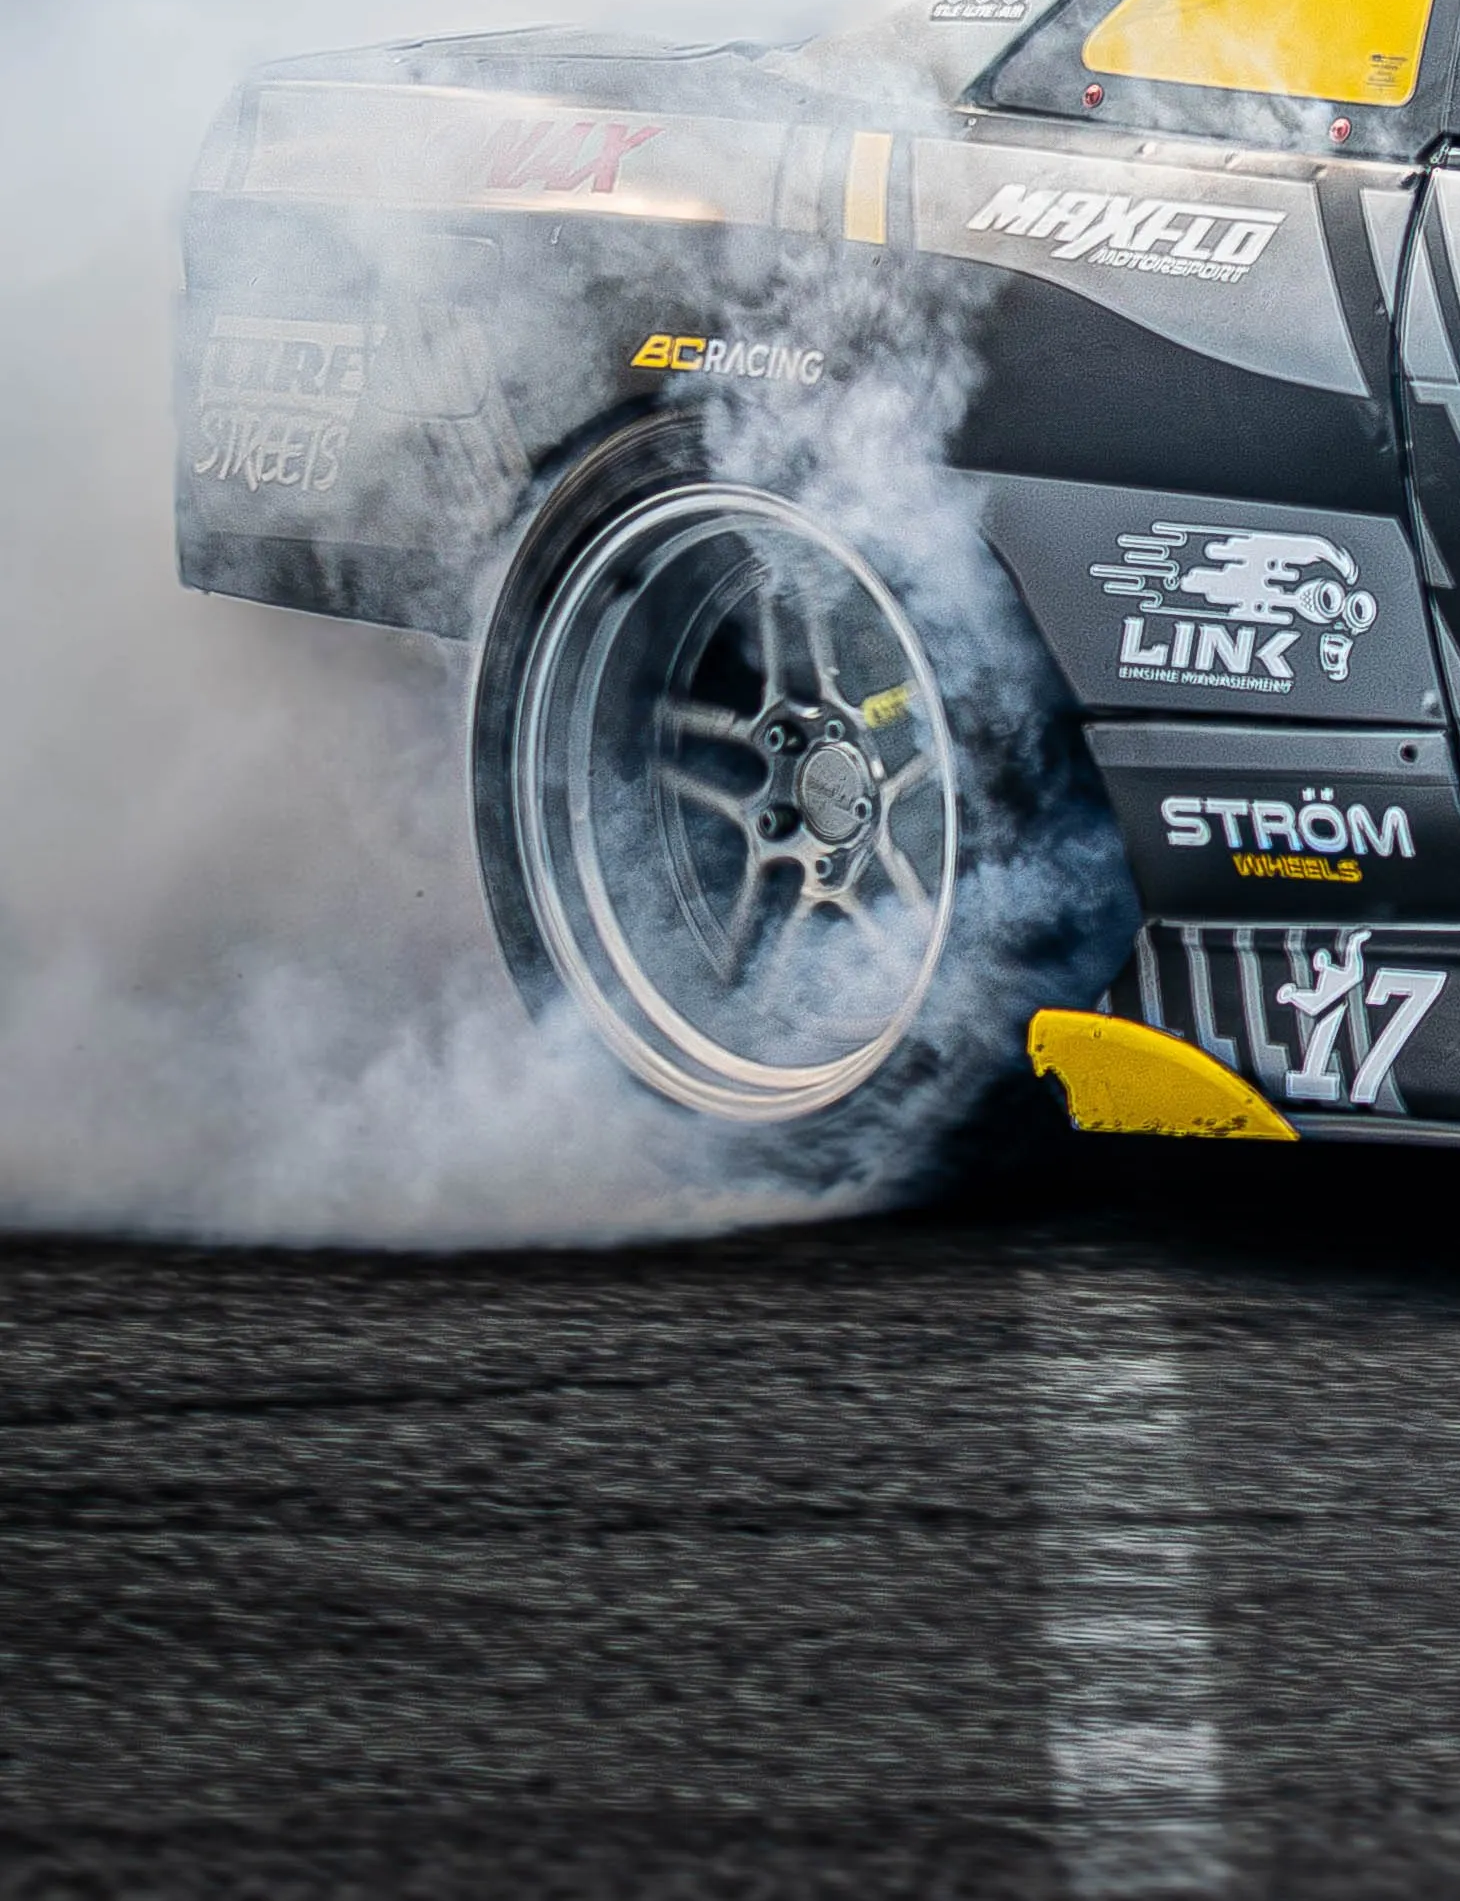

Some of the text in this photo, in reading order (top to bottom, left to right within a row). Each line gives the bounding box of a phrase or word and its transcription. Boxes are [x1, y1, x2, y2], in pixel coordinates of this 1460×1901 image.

[967, 184, 1288, 261] MAXFLO
[1089, 247, 1249, 284] MOTORSPORT
[1120, 616, 1301, 679] LINK
[1160, 787, 1416, 858] STRÖM
[1232, 853, 1363, 883] WHEELS
